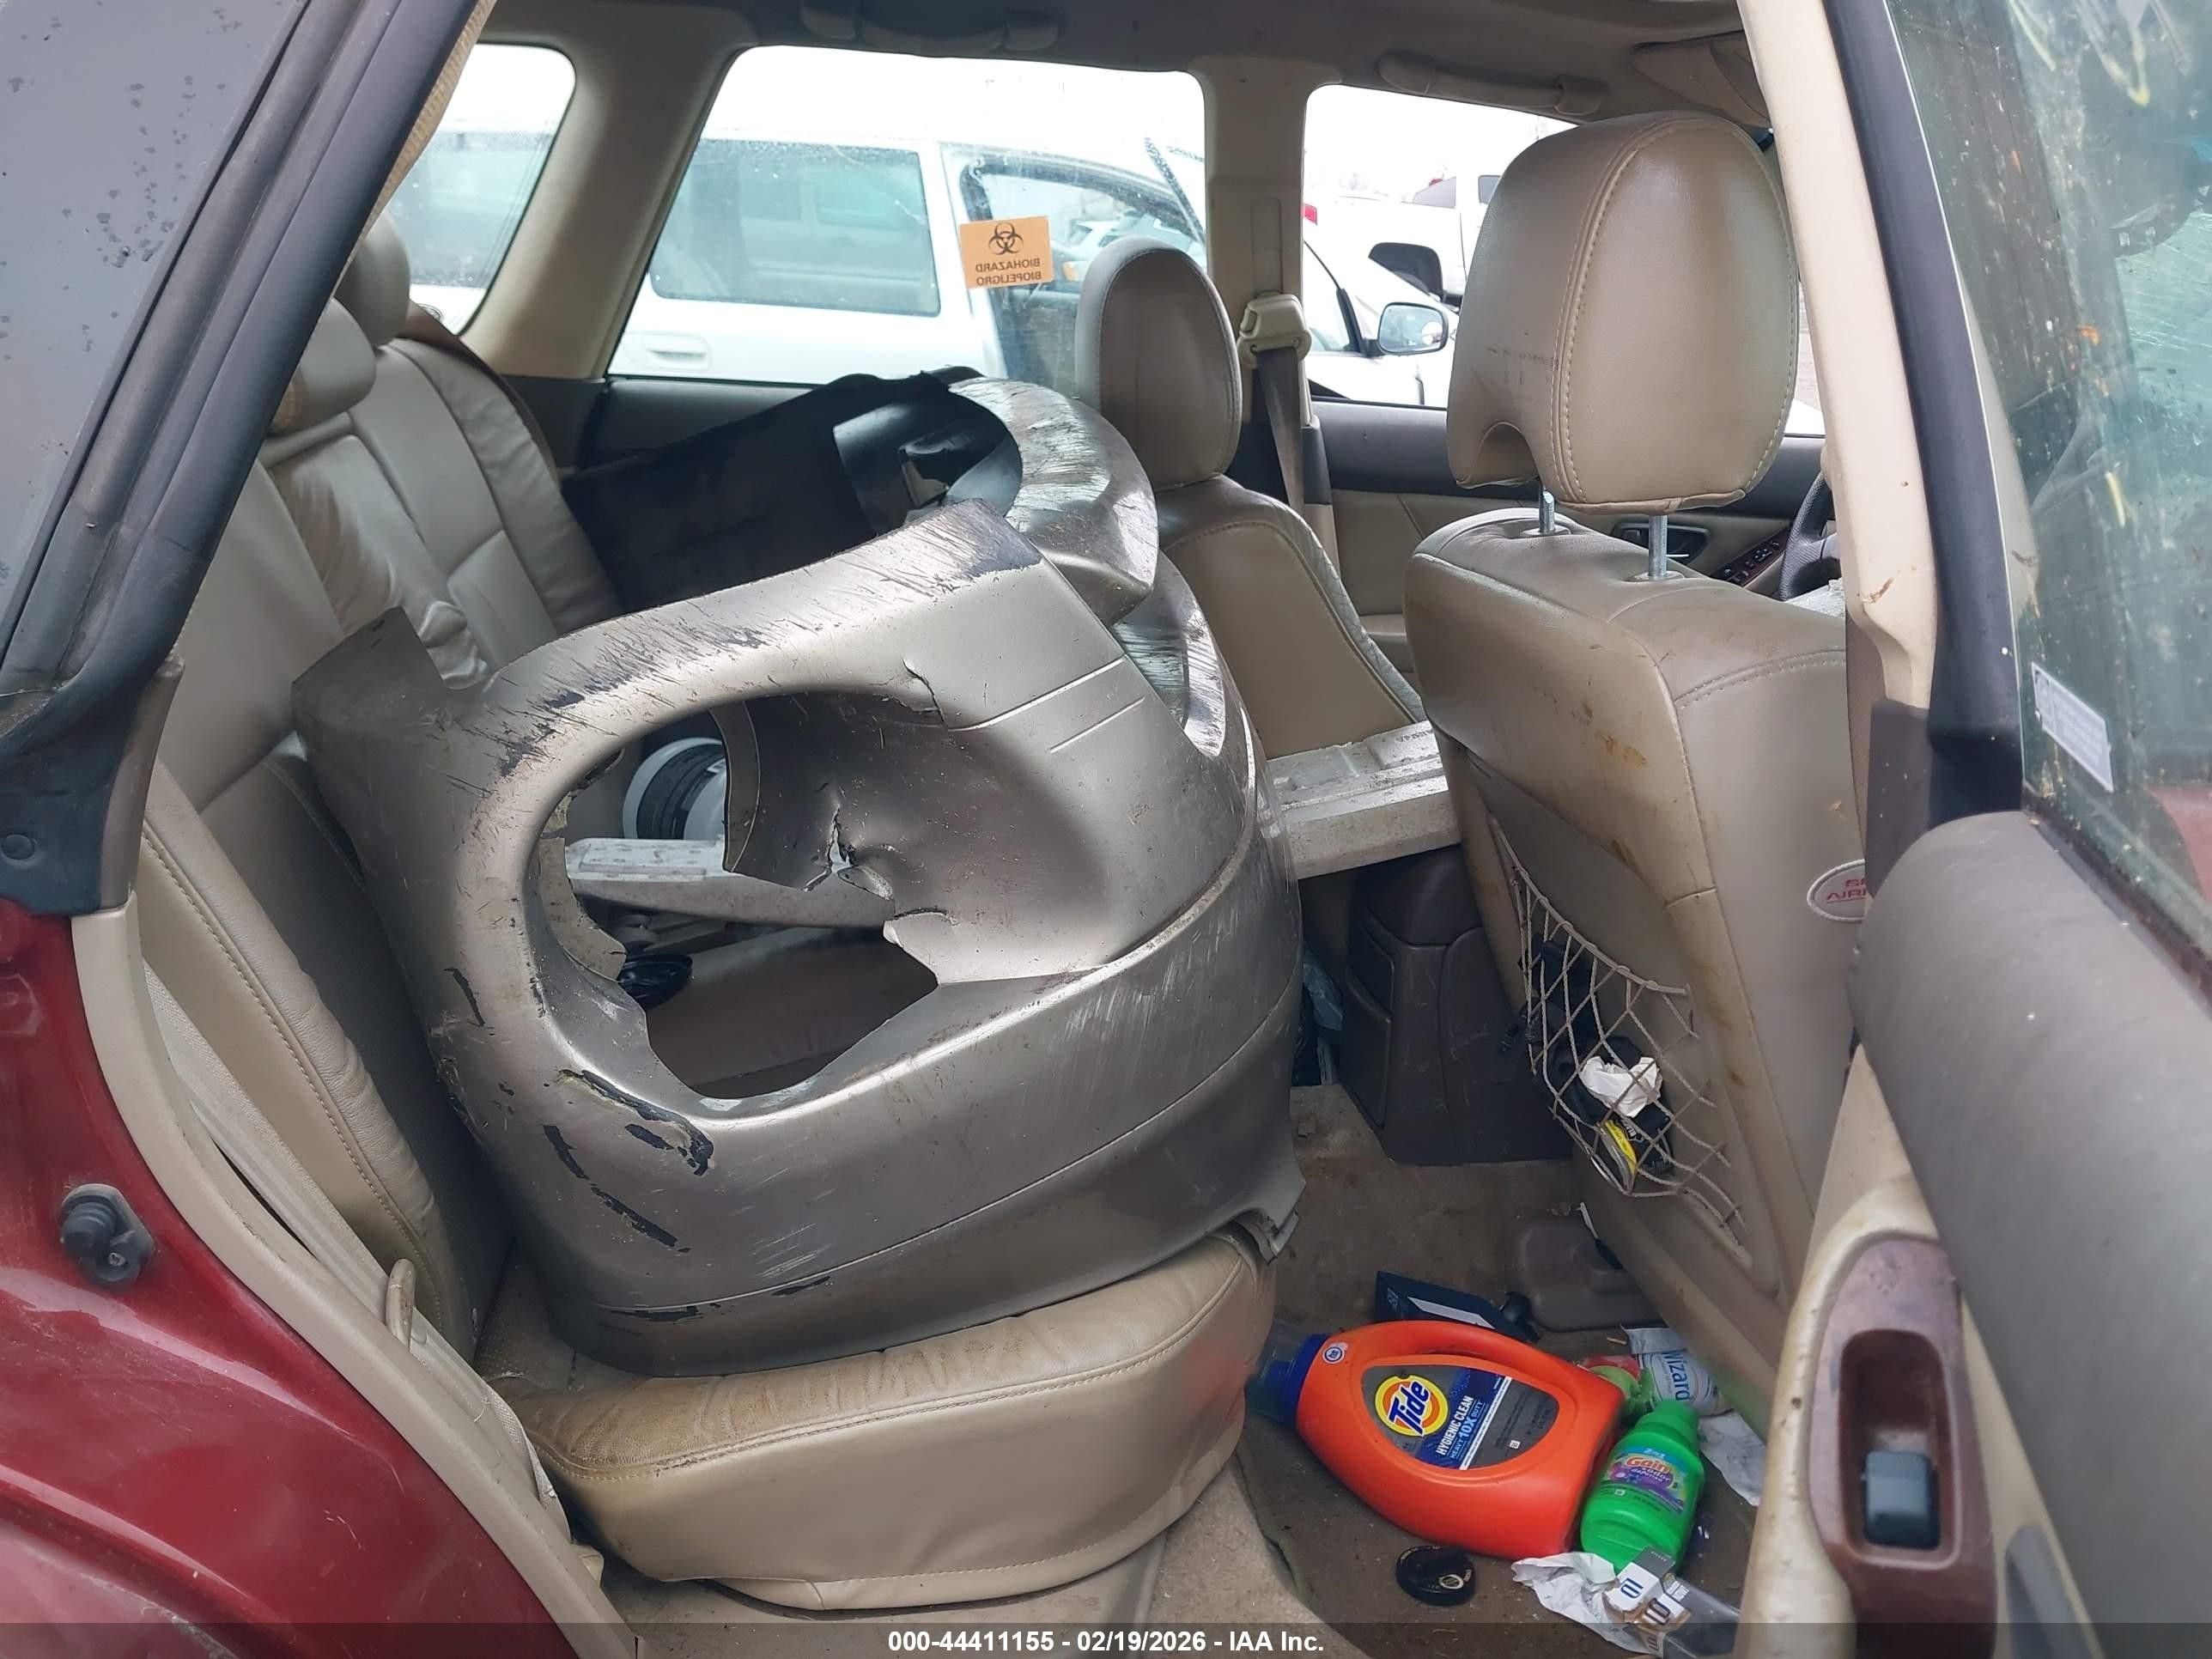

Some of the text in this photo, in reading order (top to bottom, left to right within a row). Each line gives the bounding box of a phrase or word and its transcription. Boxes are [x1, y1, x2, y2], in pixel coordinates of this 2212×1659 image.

[1388, 1381, 1430, 1436] Tide
[1436, 1420, 1461, 1455] HYGIENIC
[1454, 1395, 1474, 1421] CLEAN
[1449, 1438, 1464, 1458] HEAVY
[1459, 1416, 1477, 1437] 10X
[1471, 1400, 1483, 1418] DUTY
[1626, 1455, 1670, 1474] Gain
